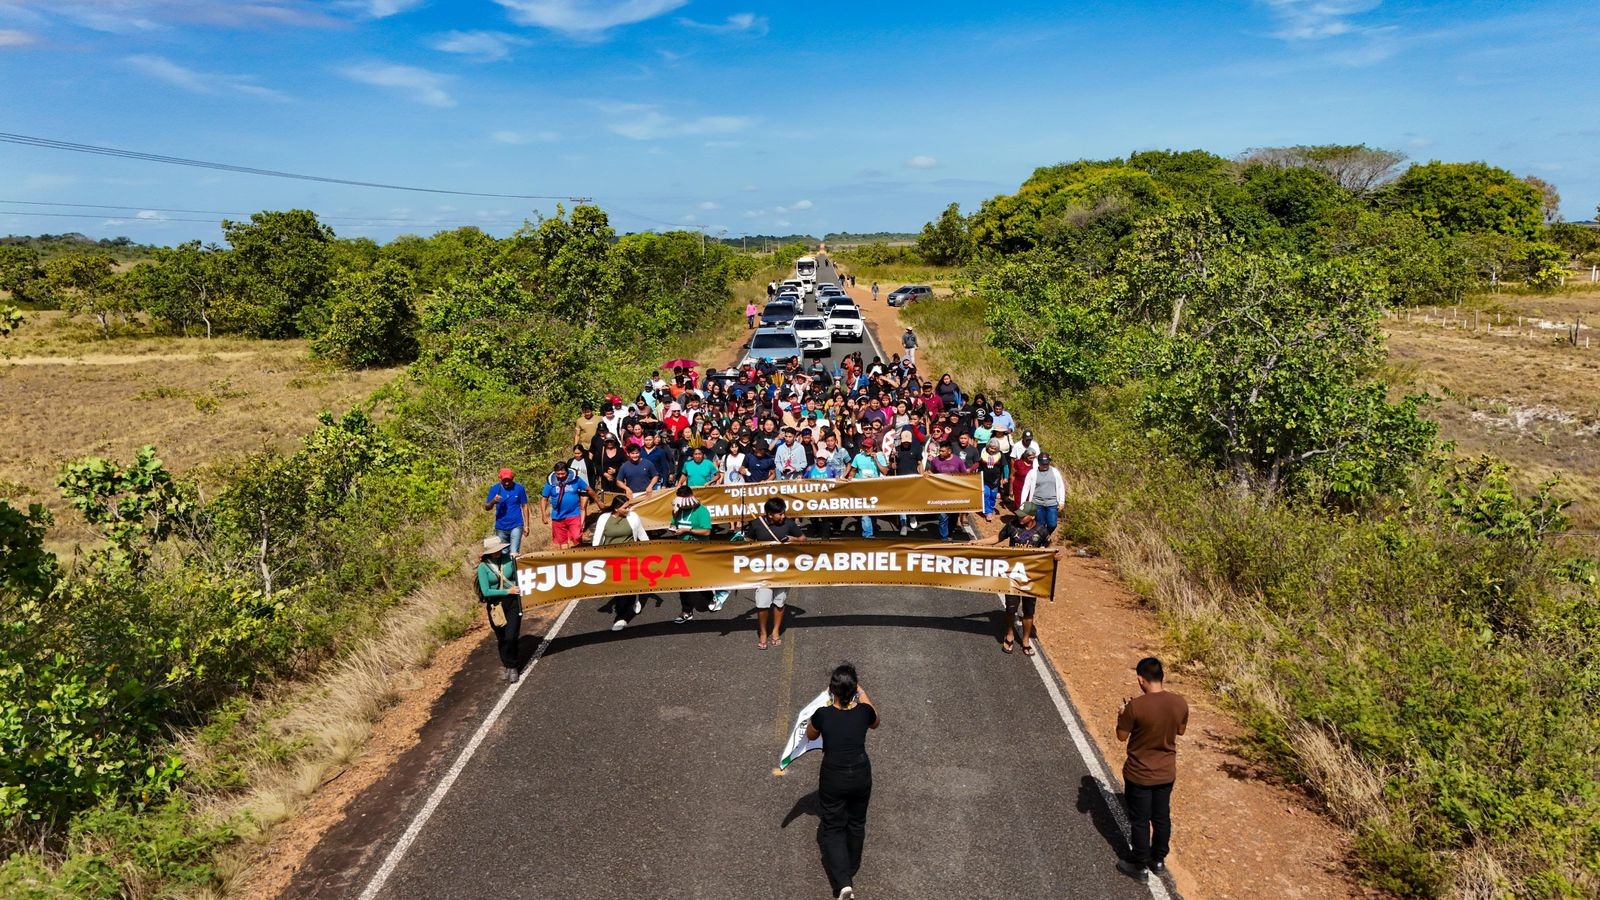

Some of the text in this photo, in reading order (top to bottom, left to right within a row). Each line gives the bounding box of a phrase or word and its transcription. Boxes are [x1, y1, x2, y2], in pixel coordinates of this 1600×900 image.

[748, 485, 779, 497] LUTO
[780, 484, 798, 495] EM
[706, 496, 879, 517] EM MAT O GABRIEL?
[517, 551, 1032, 597] #JUSTIÇA Pelo GABRIEL FERREIRA
